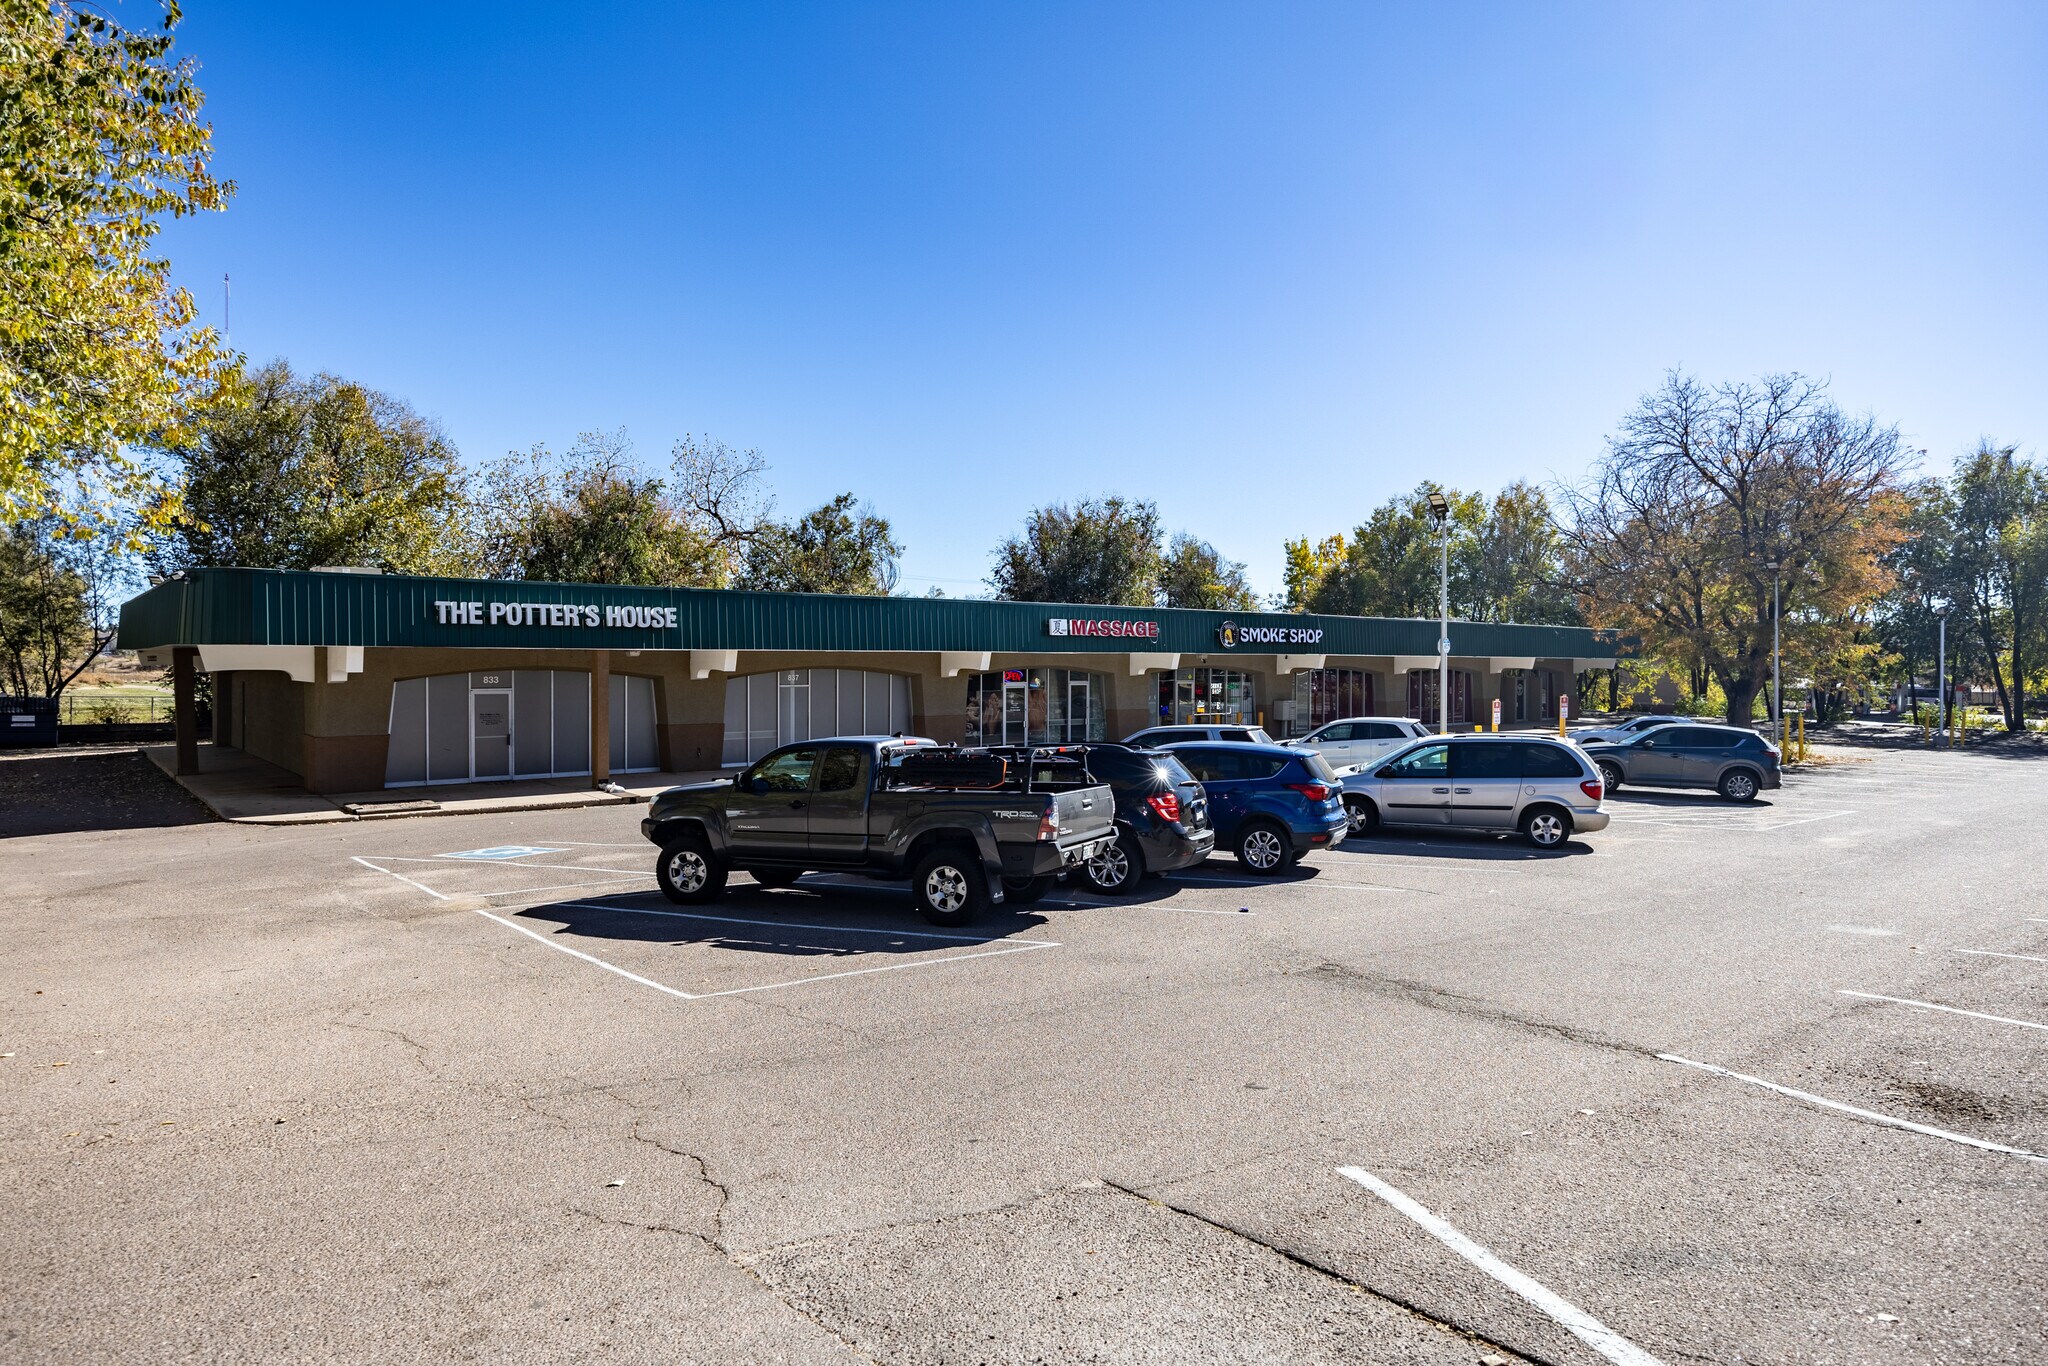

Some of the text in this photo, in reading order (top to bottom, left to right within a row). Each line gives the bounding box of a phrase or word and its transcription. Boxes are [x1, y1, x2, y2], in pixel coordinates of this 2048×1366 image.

[434, 601, 678, 629] THE POTTER'S HOUSE
[1069, 619, 1158, 637] MASSAGE
[1240, 627, 1286, 643] SMOKE
[1289, 628, 1323, 643] SHOP
[483, 676, 499, 684] 833
[1004, 671, 1021, 681] OPEN
[992, 810, 1019, 819] TRD
